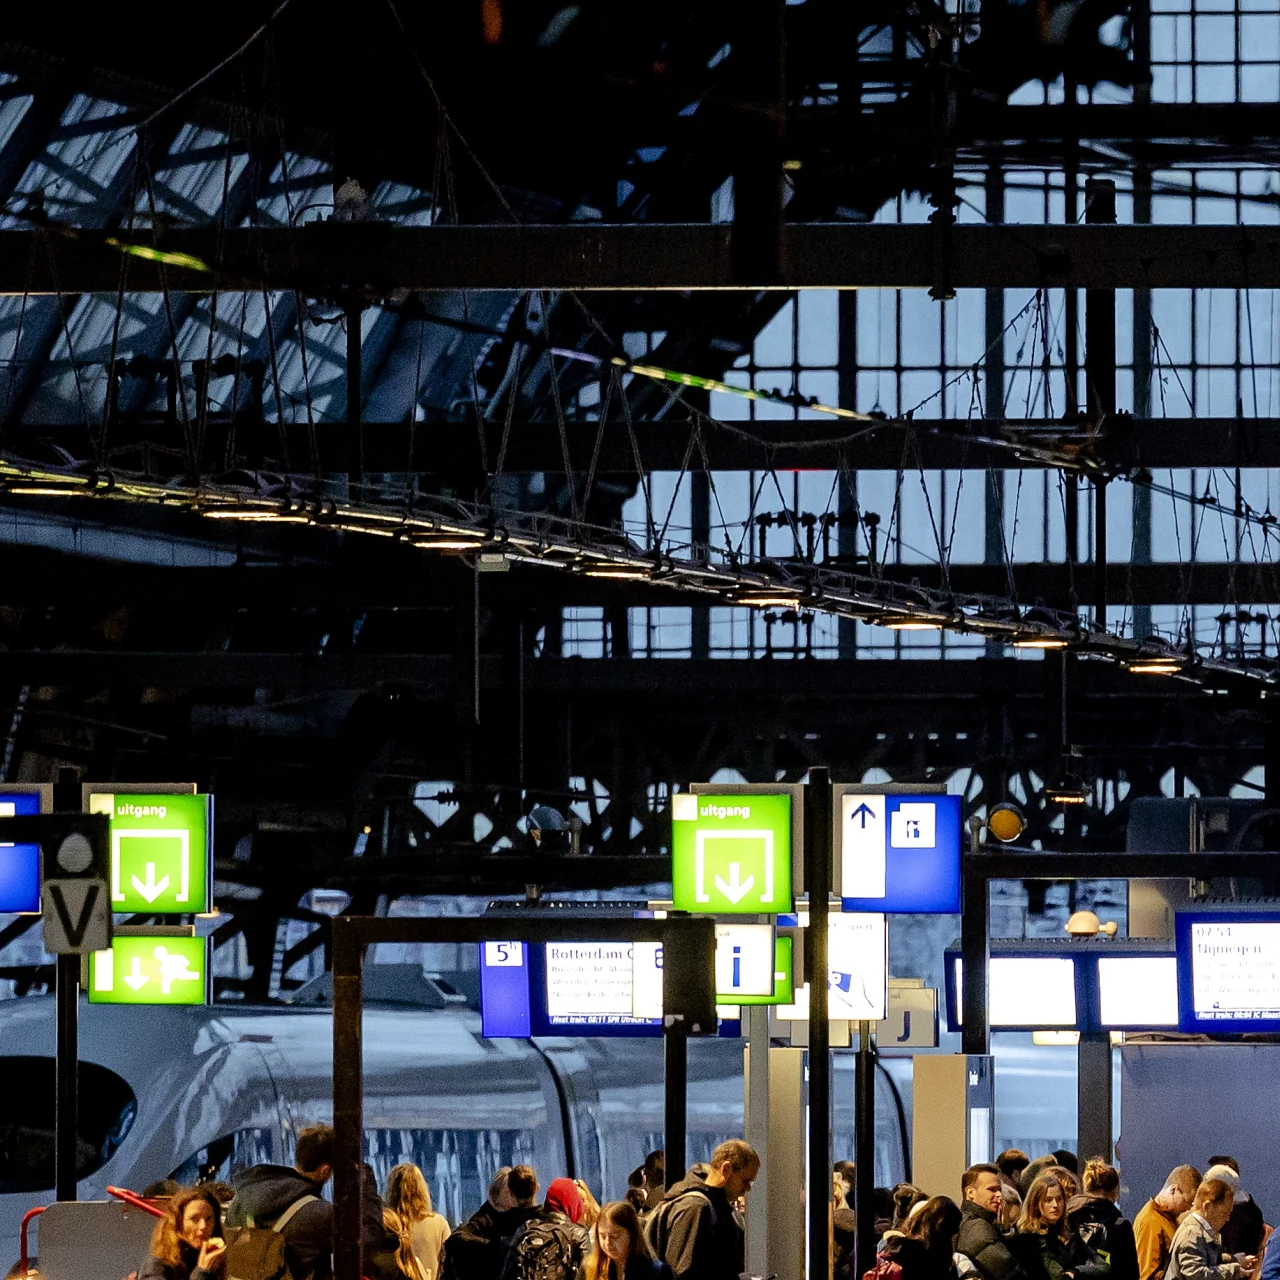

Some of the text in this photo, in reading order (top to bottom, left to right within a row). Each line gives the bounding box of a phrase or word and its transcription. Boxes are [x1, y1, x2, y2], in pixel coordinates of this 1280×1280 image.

[117, 803, 167, 818] uitgang
[700, 804, 750, 819] uitgang
[49, 885, 100, 946] V
[551, 948, 622, 960] Rotterdam
[897, 1010, 911, 1043] J
